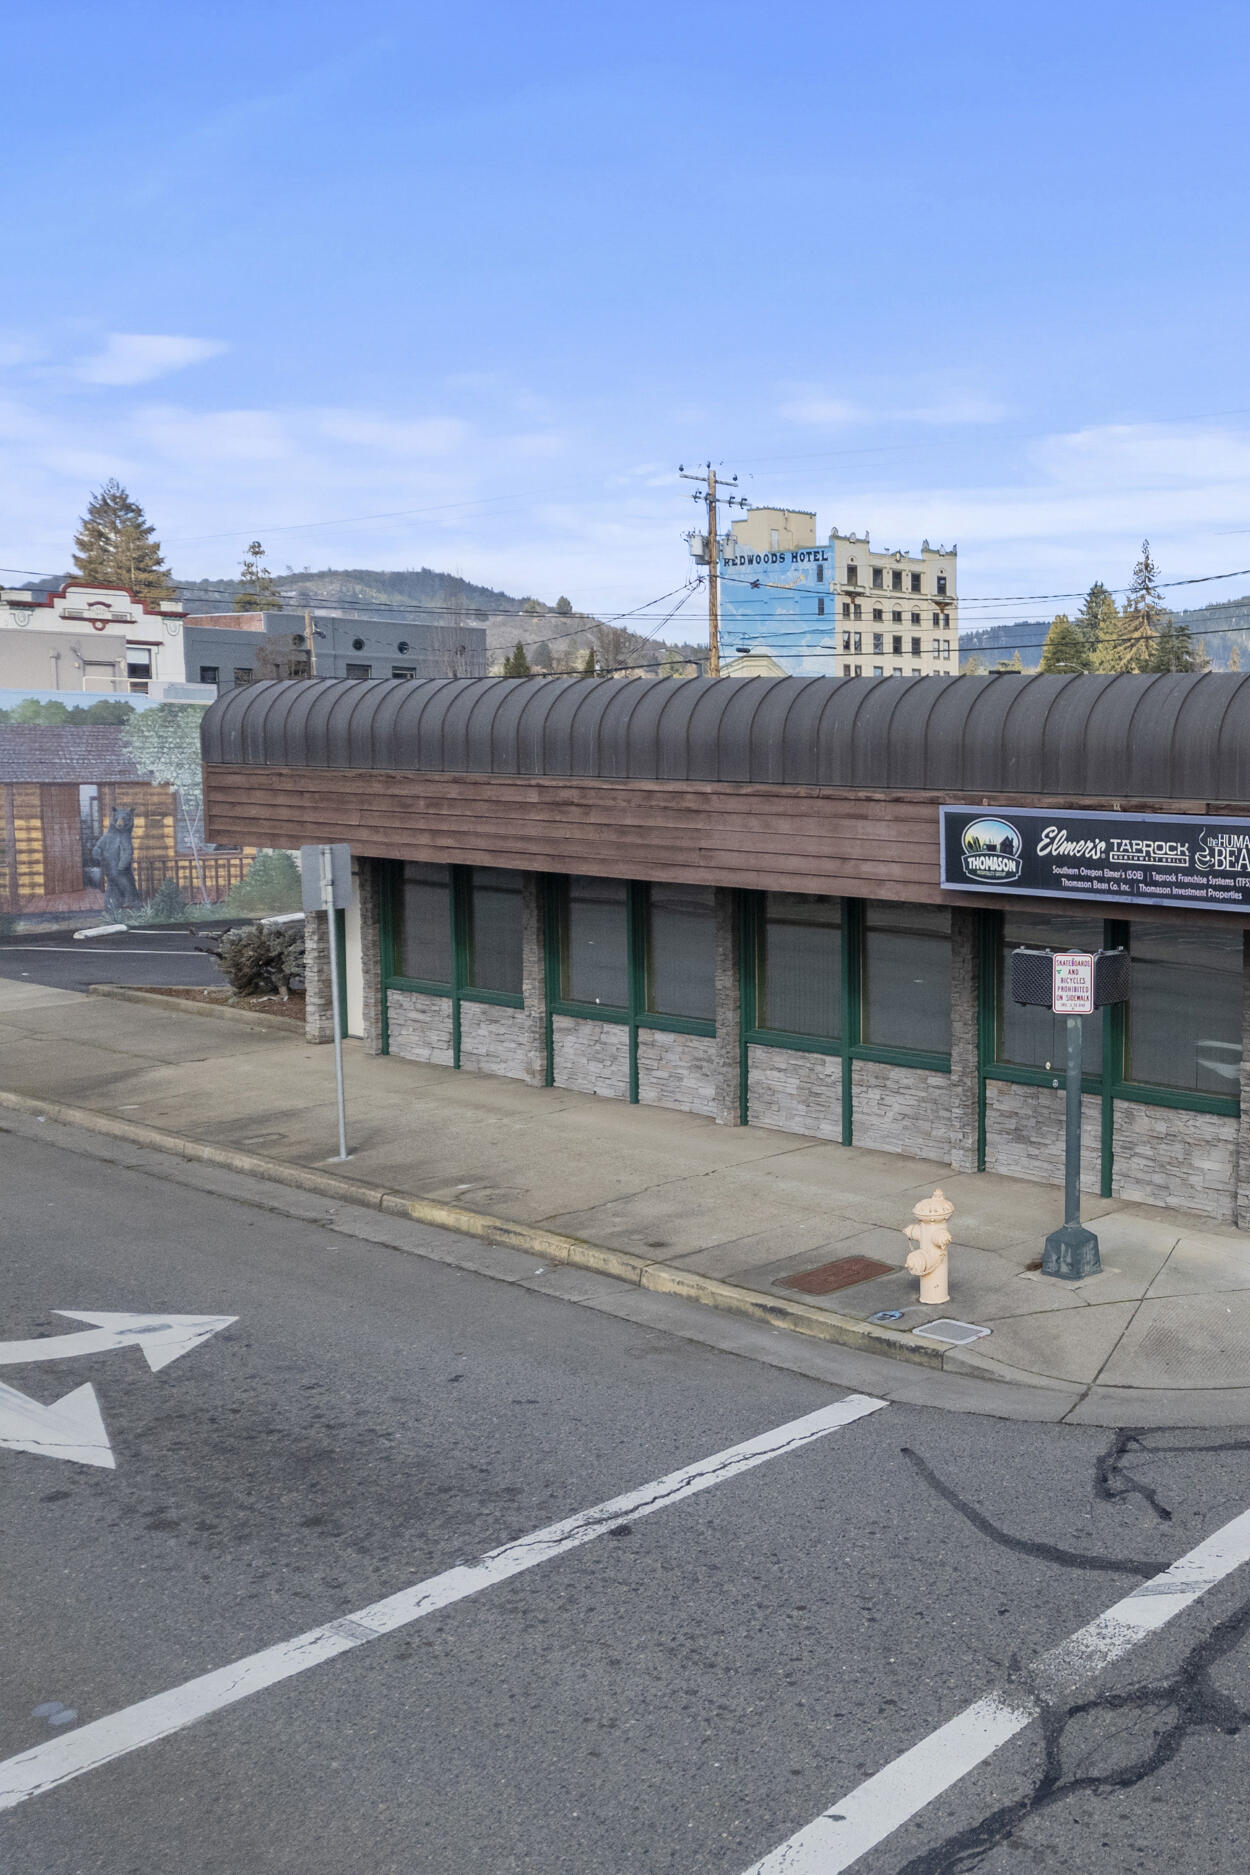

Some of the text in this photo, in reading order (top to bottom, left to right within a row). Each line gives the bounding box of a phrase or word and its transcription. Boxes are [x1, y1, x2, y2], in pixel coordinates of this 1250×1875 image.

[723, 550, 829, 567] REDWOODS HOTEL
[1036, 826, 1106, 860] Elmer's
[1110, 839, 1190, 856] TAPROCK
[1207, 836, 1218, 847] the
[967, 857, 1016, 872] THOMASON
[1052, 865, 1144, 880] Southern Oregon Elmer's (SOE)
[1151, 872, 1177, 883] Taprock
[1177, 873, 1208, 884] Franchise
[1208, 875, 1235, 887] Systems
[1061, 878, 1092, 888] Thomason
[1092, 880, 1109, 889] Bean
[1138, 883, 1243, 900] Thomason Investment Properties
[1060, 977, 1086, 985] BICYCLES
